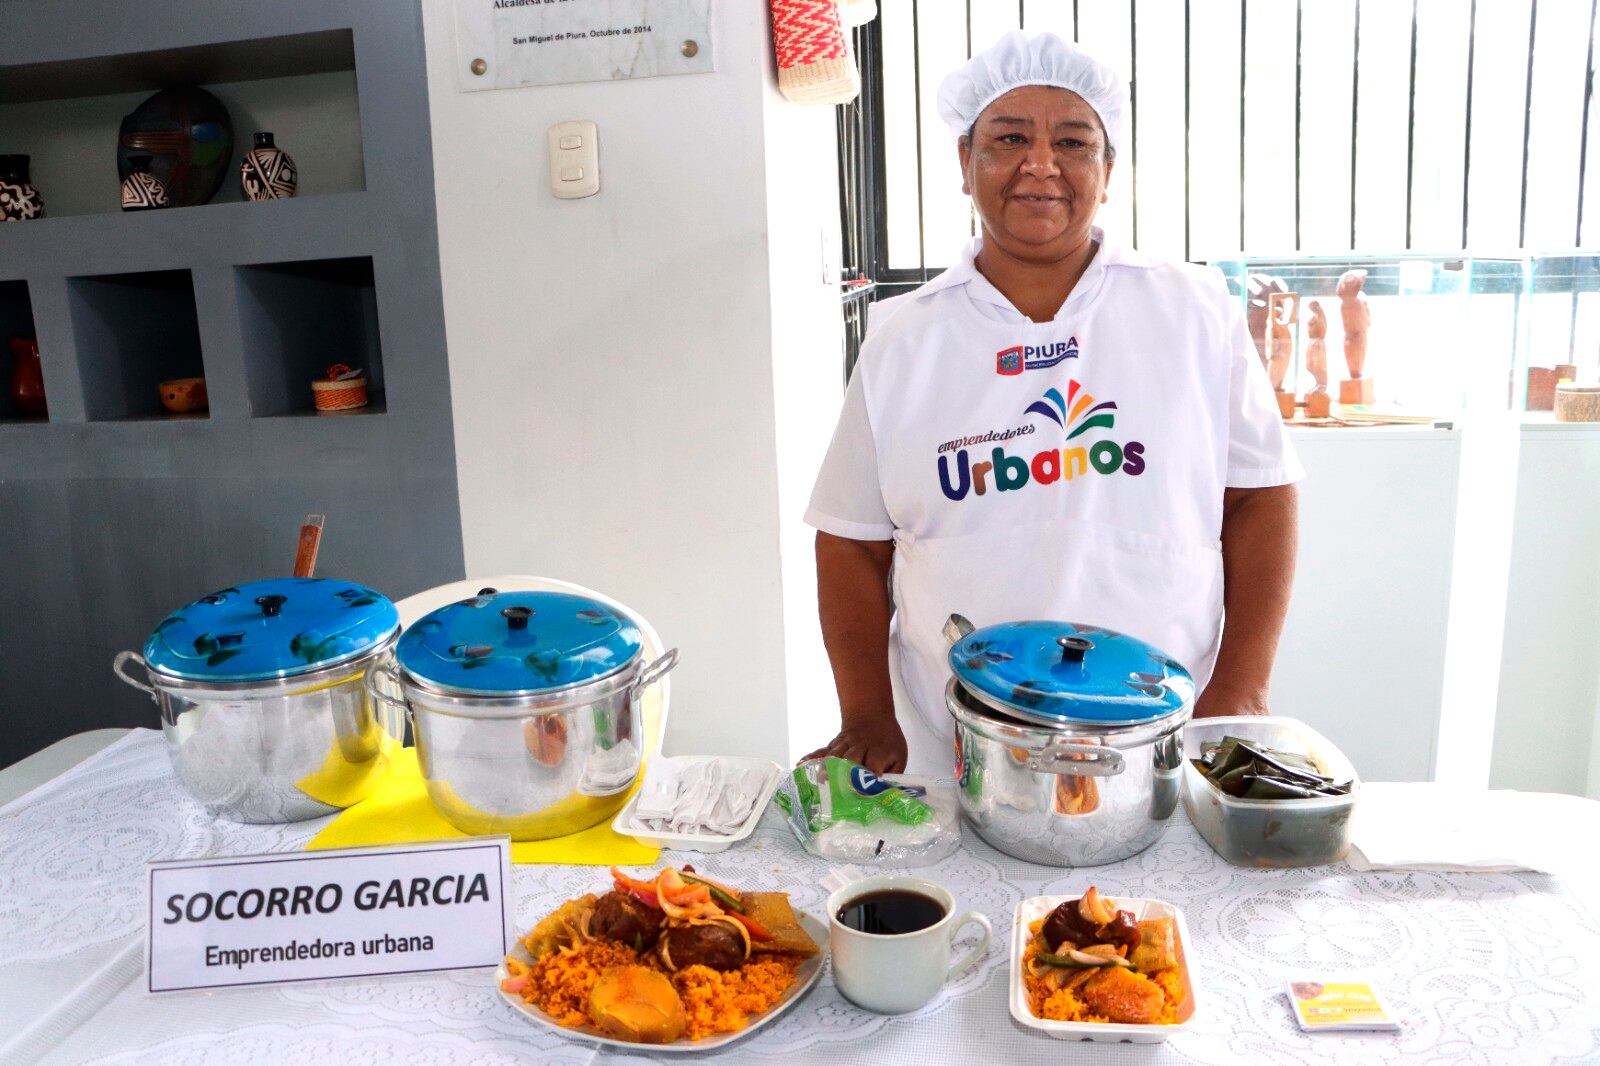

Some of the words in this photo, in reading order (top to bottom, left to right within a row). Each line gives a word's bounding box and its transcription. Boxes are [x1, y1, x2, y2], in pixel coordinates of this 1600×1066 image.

[512, 37, 527, 45] San
[529, 34, 553, 44] Miguel
[555, 33, 565, 41] de
[590, 28, 620, 38] Octubre
[622, 27, 632, 35] de
[634, 25, 652, 34] 2014
[1024, 336, 1079, 360] PIURA
[937, 424, 1036, 455] emprendedores
[937, 440, 1146, 501] Urbanos
[163, 883, 344, 925] SOCORRO
[353, 873, 490, 911] GARCIA
[205, 939, 355, 970] Emprendedora
[362, 934, 434, 955] urbana
